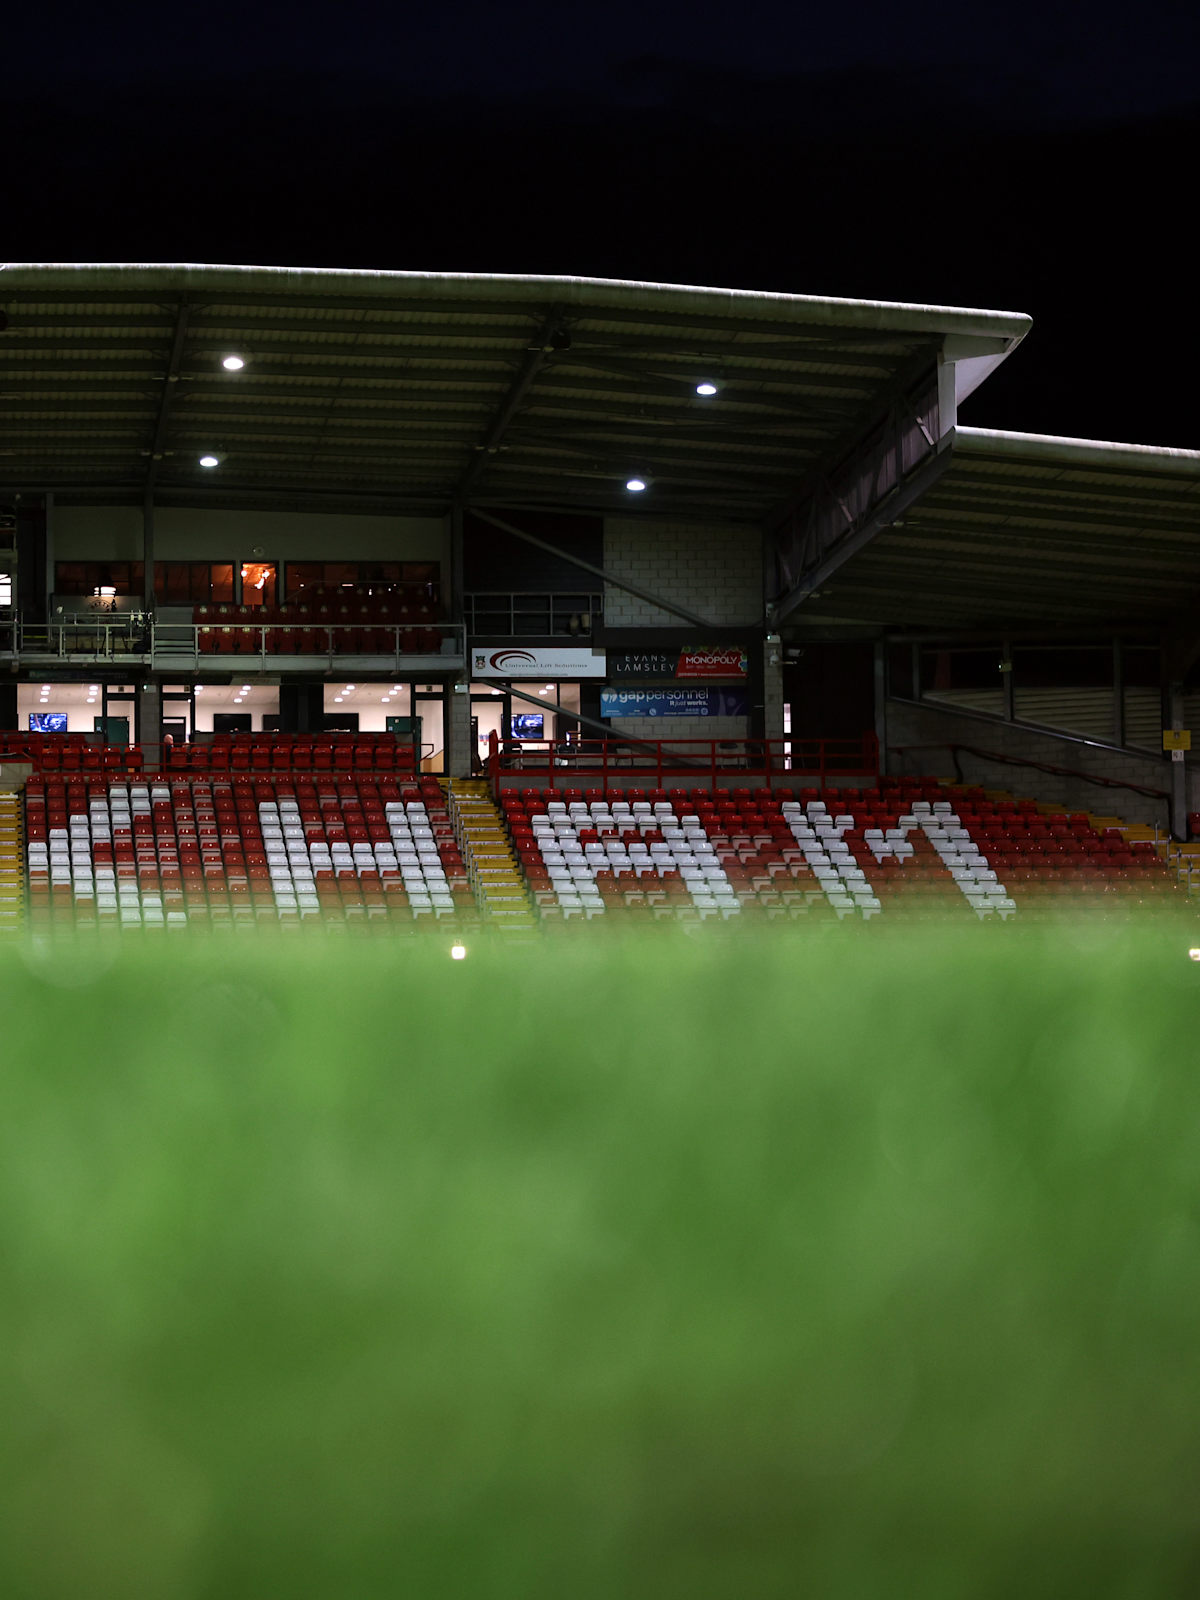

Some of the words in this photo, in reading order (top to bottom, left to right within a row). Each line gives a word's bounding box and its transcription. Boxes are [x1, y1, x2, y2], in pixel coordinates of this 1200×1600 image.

[624, 654, 667, 663] EVANS
[685, 656, 738, 665] MONOPOLY
[616, 663, 675, 672] LAMSLEY
